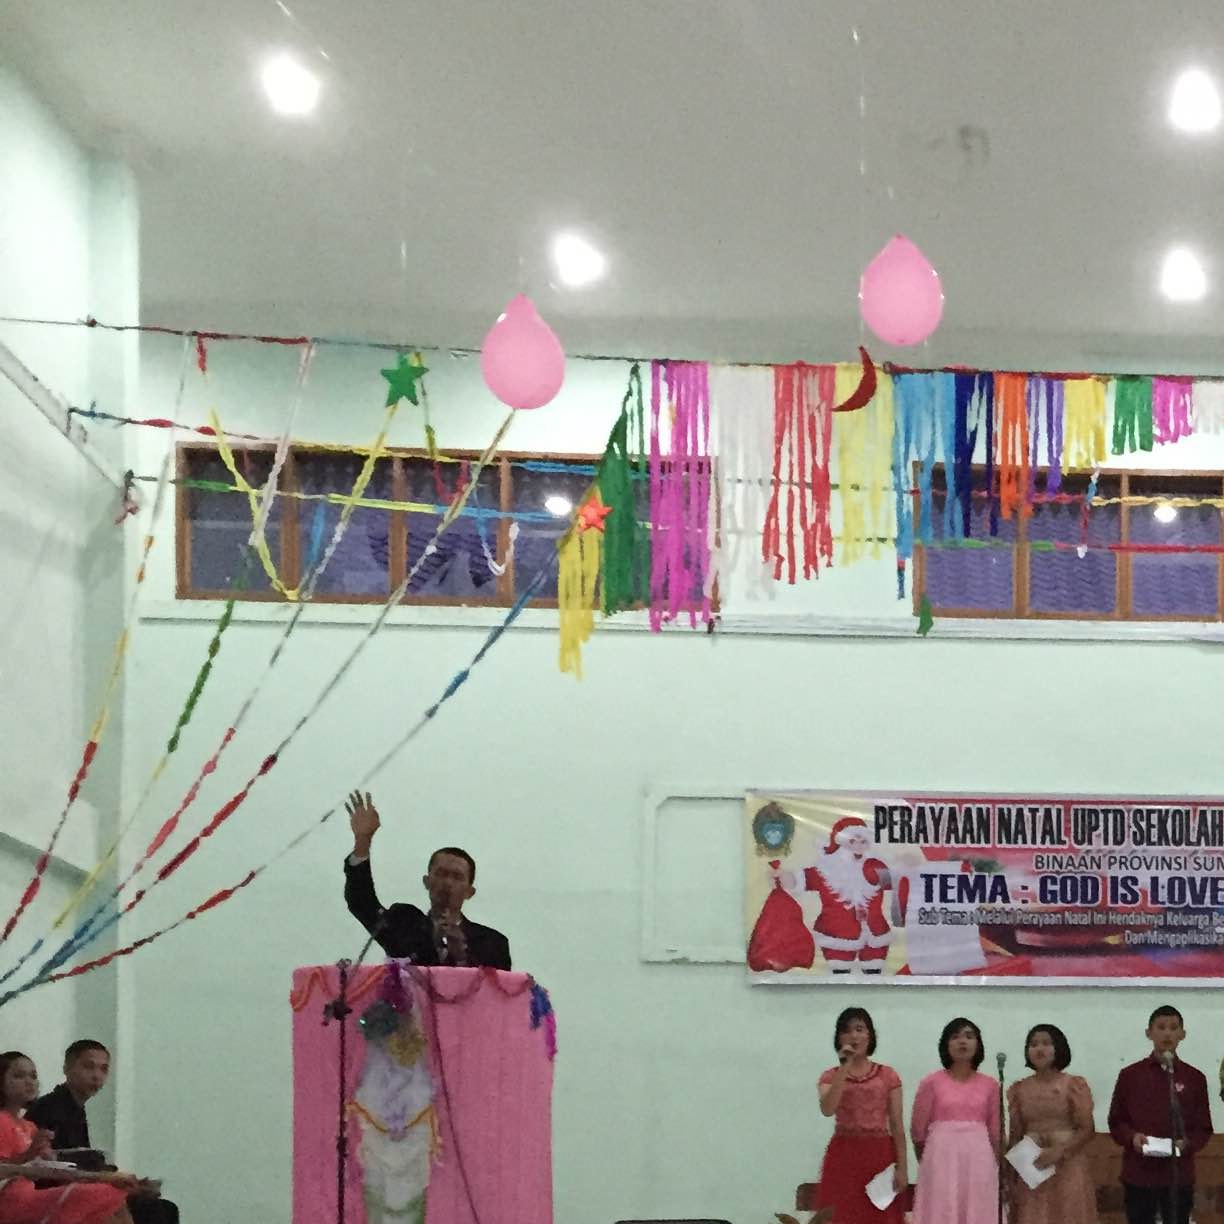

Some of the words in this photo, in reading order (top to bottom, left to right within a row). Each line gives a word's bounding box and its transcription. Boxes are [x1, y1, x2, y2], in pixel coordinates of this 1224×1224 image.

[874, 805, 990, 844] PERAYAAN
[997, 807, 1066, 845] NATAL
[1073, 808, 1126, 846] UPTD
[1132, 809, 1224, 847] SEKOLAH
[1035, 855, 1102, 870] BINAAN
[1108, 855, 1187, 871] PROVINSI
[920, 874, 1011, 904] TEMA
[1039, 875, 1100, 905] GOD
[1110, 876, 1140, 905] IS
[1016, 911, 1062, 927] Perayaan
[1065, 911, 1091, 925] Natal
[1109, 911, 1164, 928] Hendaknya
[1167, 912, 1210, 928] Keluarga
